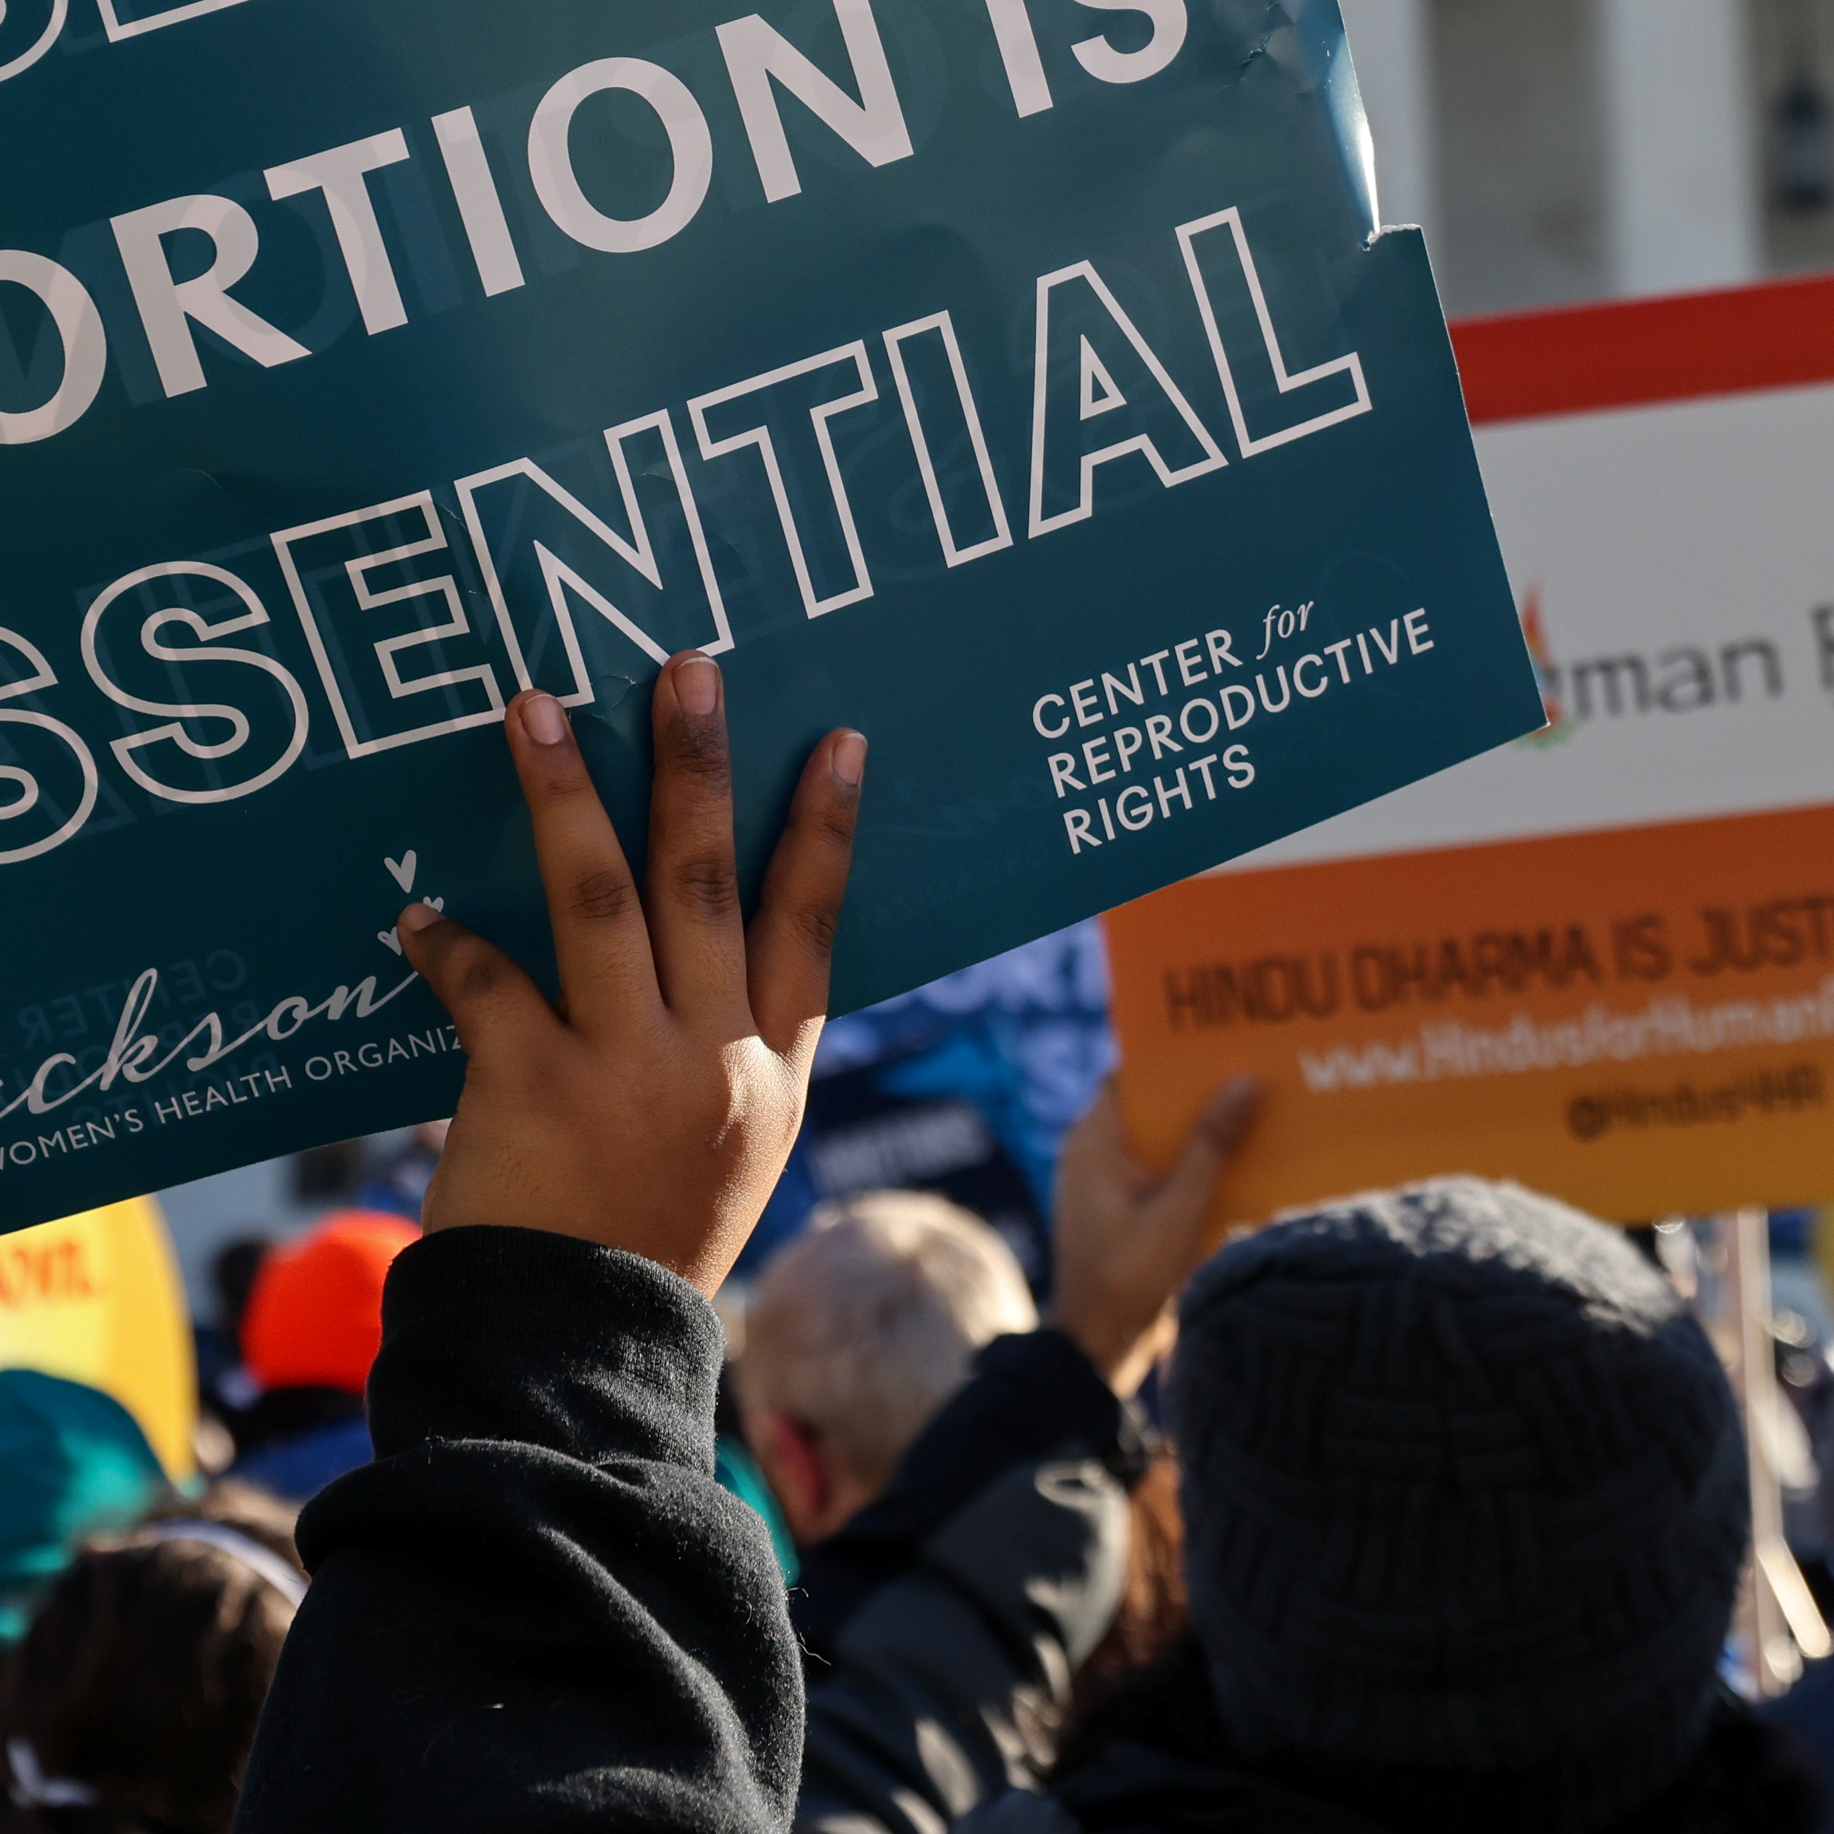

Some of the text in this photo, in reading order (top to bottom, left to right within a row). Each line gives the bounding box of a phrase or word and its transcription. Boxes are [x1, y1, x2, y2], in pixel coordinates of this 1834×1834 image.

[1032, 599, 1316, 740] CENTER for
[1047, 606, 1435, 798] REPRODUCTIVE
[1063, 743, 1256, 855] RIGHTS
[1166, 954, 1341, 1030] HINDU
[1351, 921, 1604, 1015] DHARMA
[1611, 912, 1673, 982] IS
[154, 1065, 293, 1125] HEALTH
[305, 1024, 463, 1081] ORGANIZ
